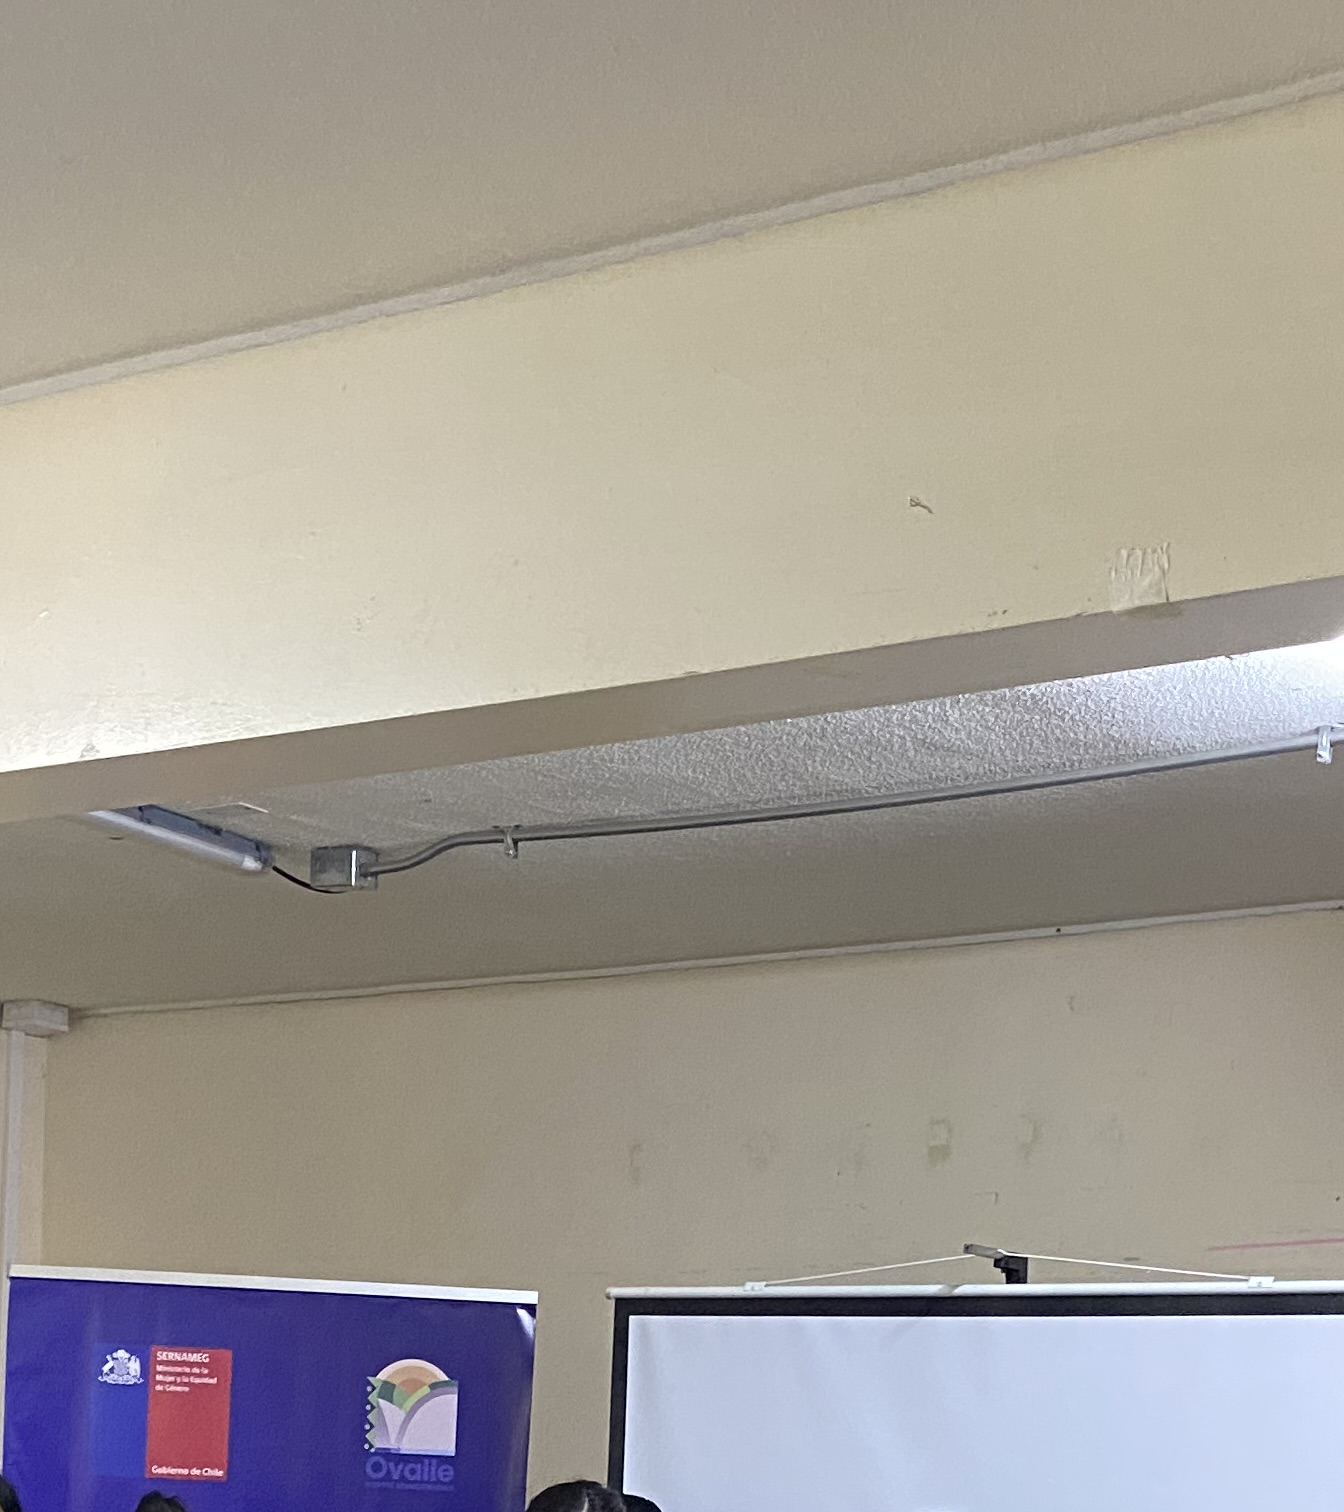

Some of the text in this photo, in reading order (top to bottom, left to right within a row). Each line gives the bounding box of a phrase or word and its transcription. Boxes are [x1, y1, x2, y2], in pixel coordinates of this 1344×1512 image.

[156, 1351, 209, 1362] SERNAMEG
[151, 1465, 224, 1476] Gobierno de Chile
[365, 1456, 454, 1482] Ovalle
